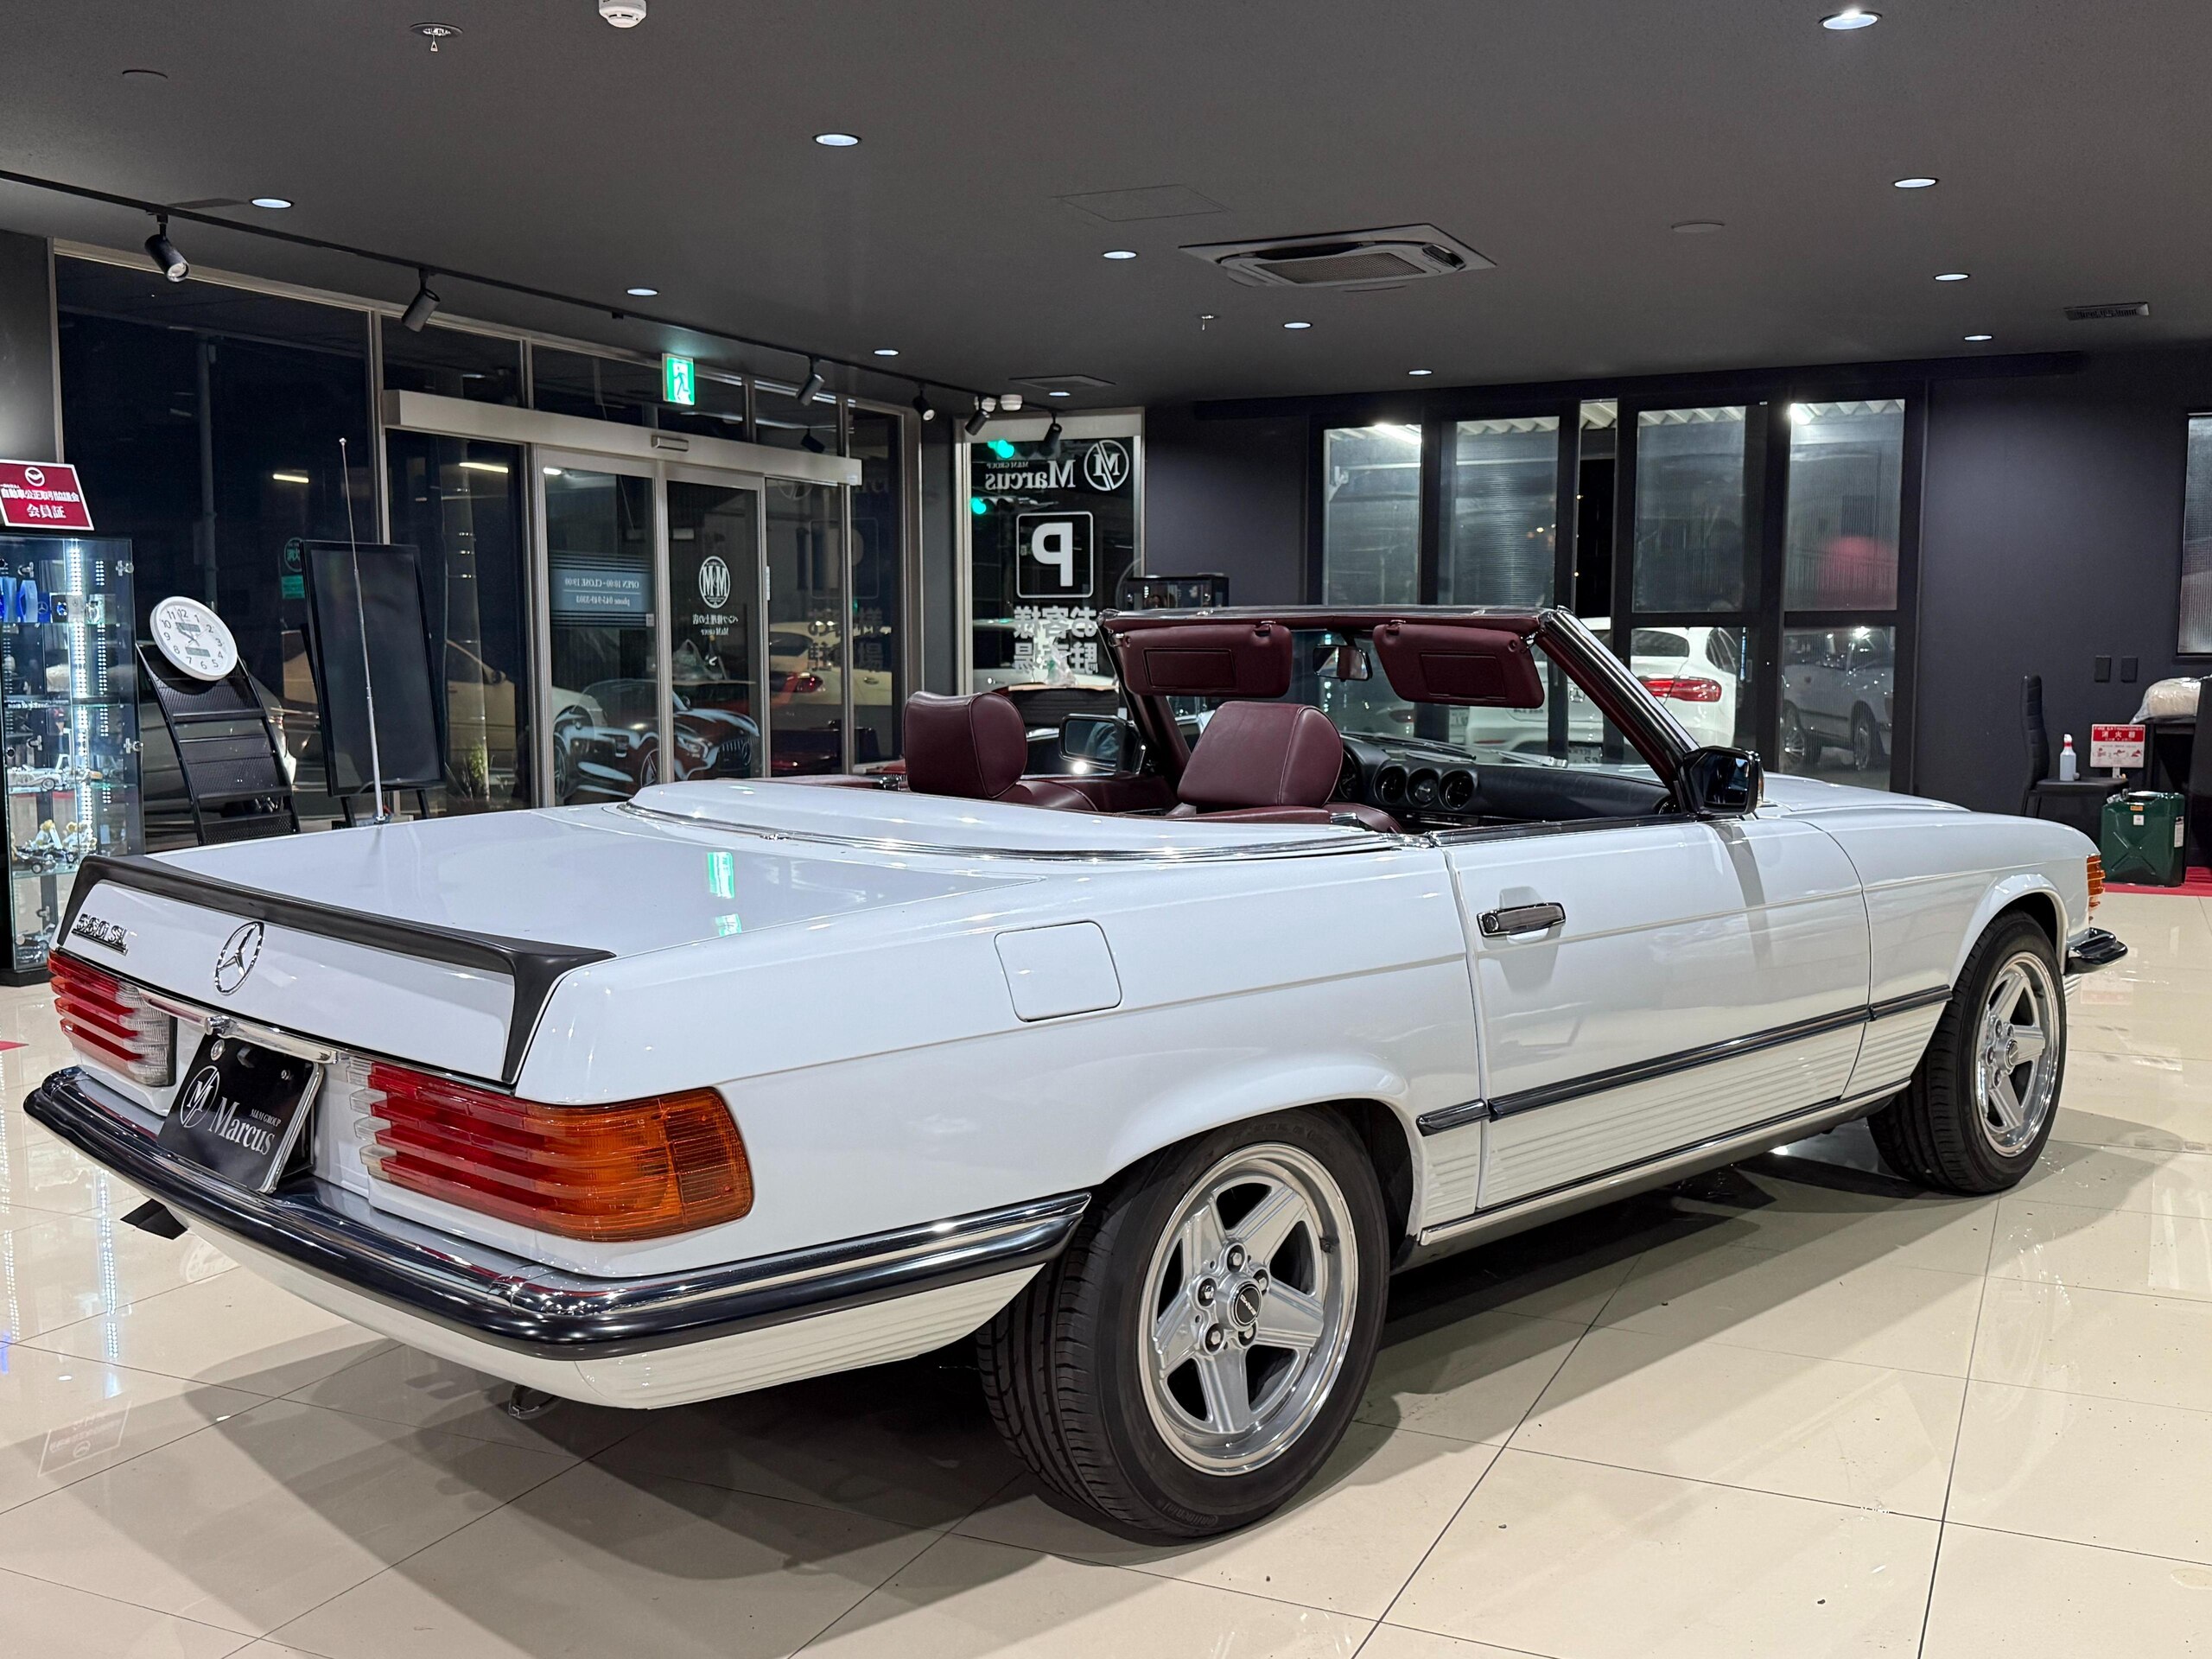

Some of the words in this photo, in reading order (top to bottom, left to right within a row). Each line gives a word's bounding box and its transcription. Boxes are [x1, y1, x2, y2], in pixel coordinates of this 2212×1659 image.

[27, 503, 67, 518] 会員証
[167, 610, 176, 620] 11
[178, 608, 188, 618] 12
[162, 620, 171, 628] 10
[207, 624, 213, 632] 2
[174, 645, 180, 654] 8
[200, 661, 207, 670] 6
[207, 1096, 275, 1155] Marcus
